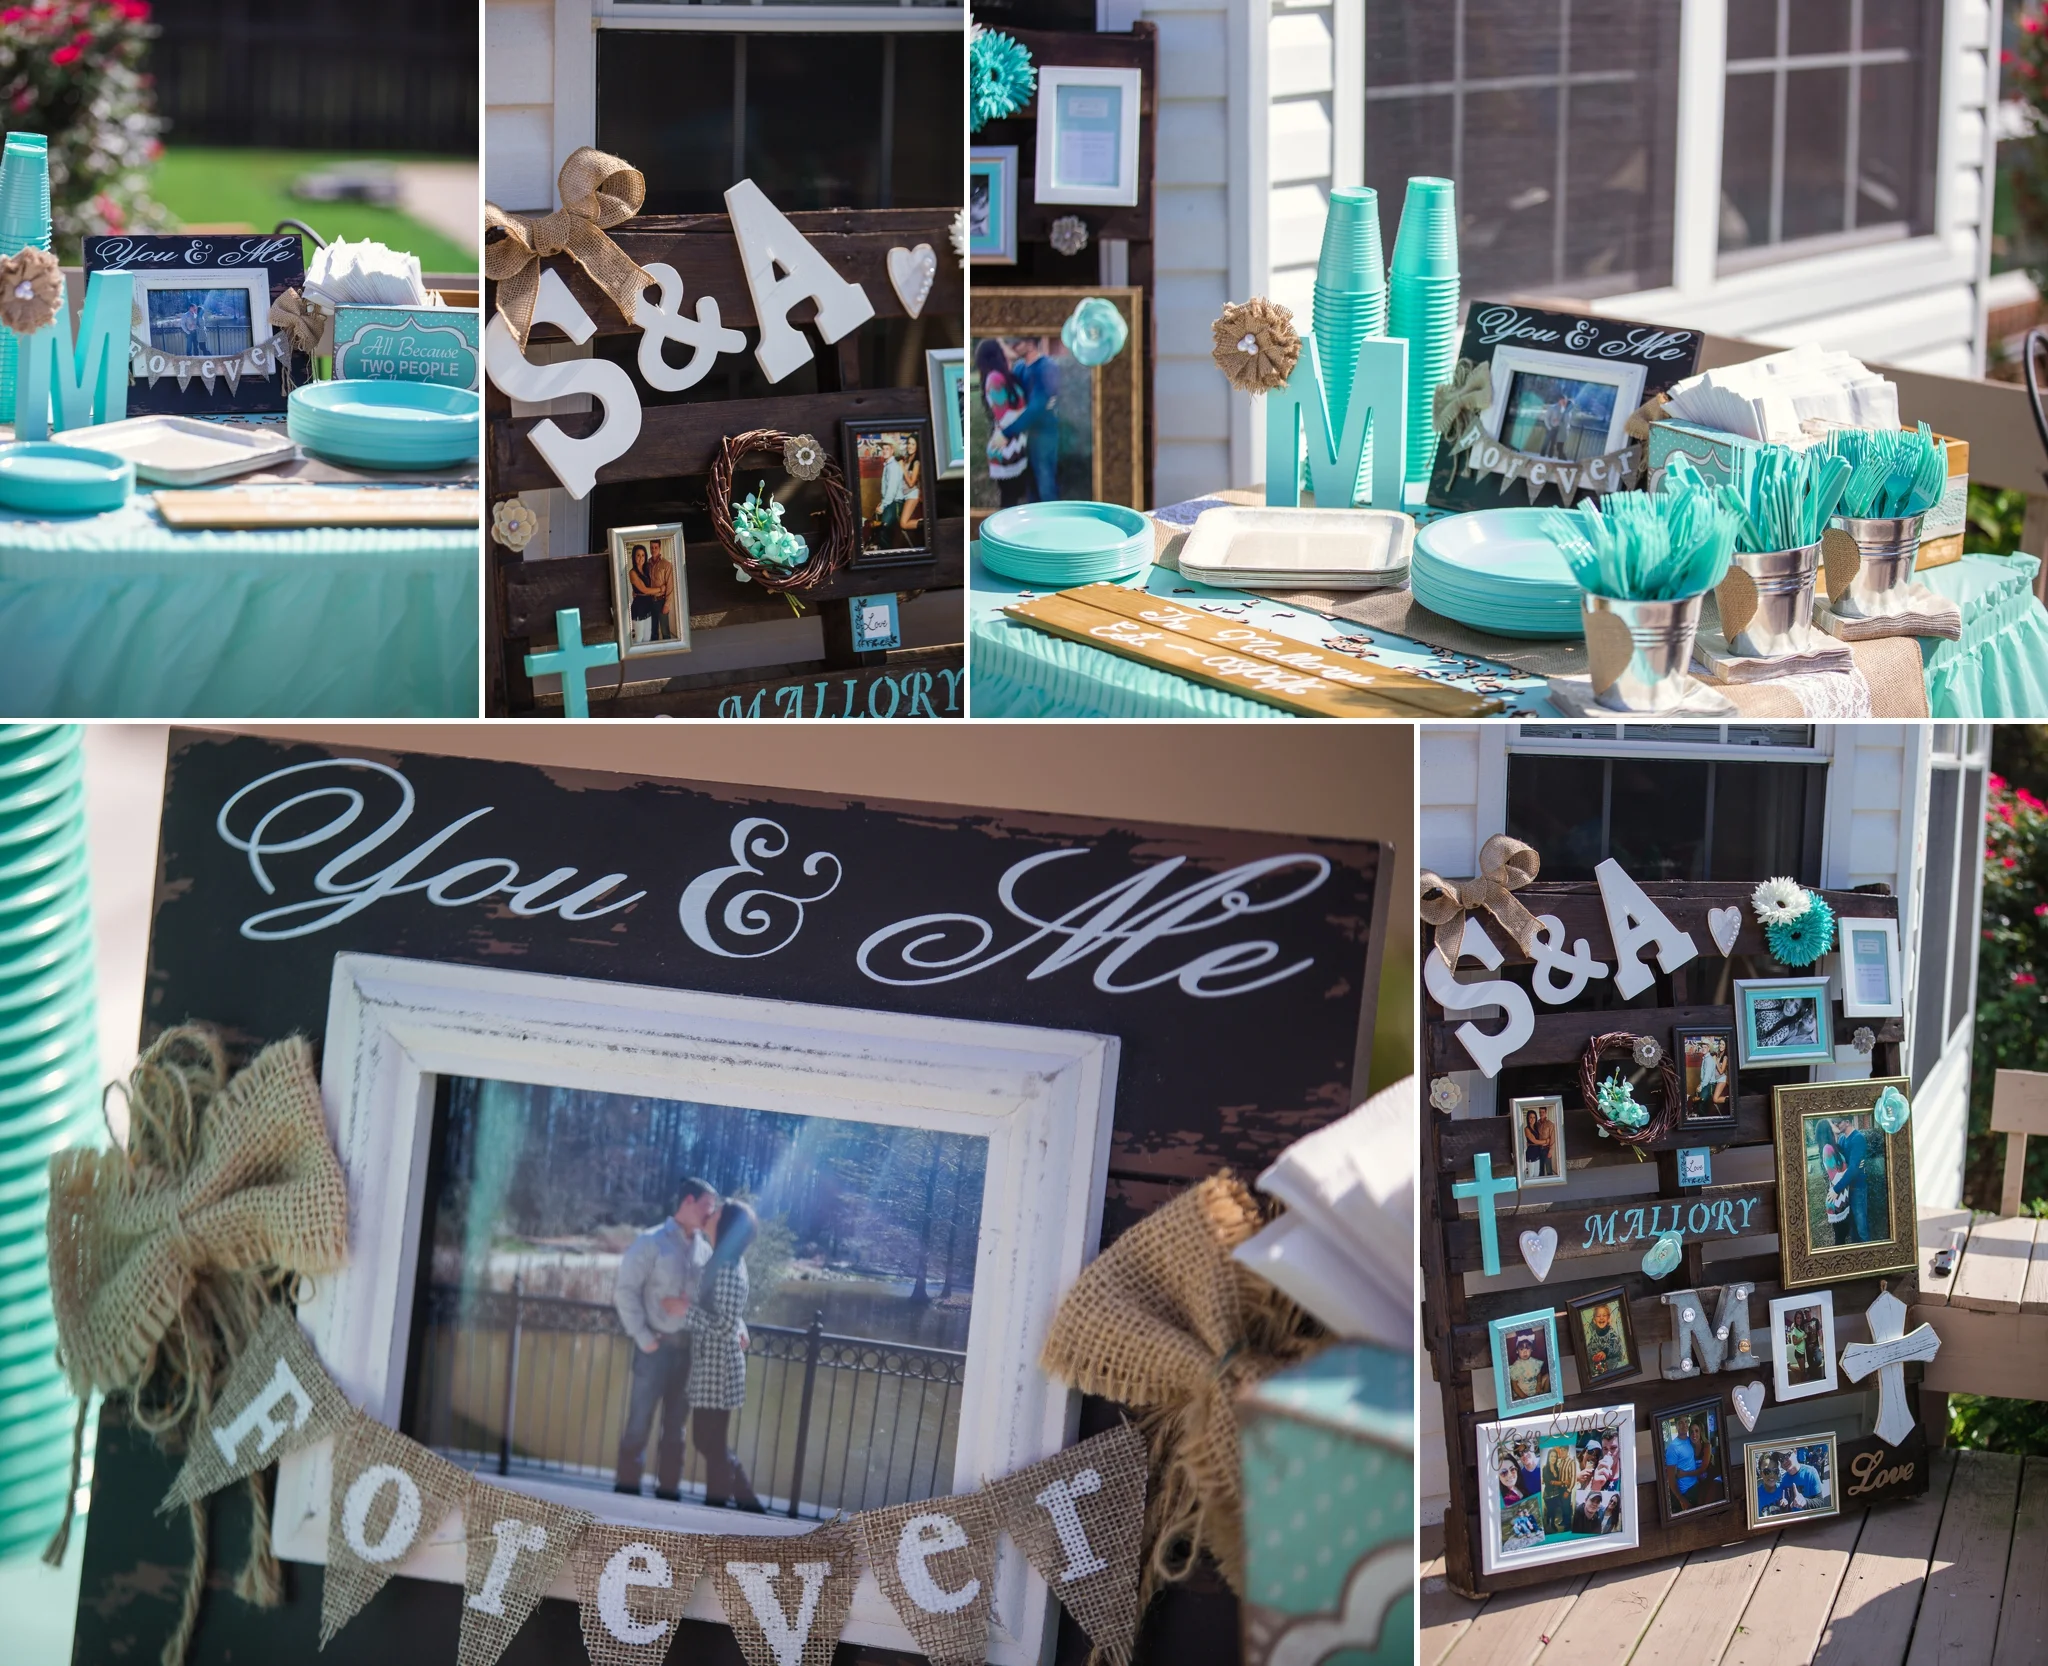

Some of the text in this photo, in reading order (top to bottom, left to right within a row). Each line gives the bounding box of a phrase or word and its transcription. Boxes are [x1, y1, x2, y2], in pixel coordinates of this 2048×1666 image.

[96, 236, 296, 271] You & Me
[361, 335, 459, 359] All Because
[1476, 305, 1692, 361] You & Me
[360, 358, 460, 377] TWO PEOPLE
[1459, 425, 1634, 495] Forever
[863, 612, 889, 631] Love
[1138, 606, 1205, 631] The
[717, 667, 965, 719] MALLORY
[216, 757, 1332, 999] You & Me
[1686, 1159, 1704, 1173] Love
[1582, 1197, 1758, 1249] MALLORY
[1661, 1282, 1760, 1381] M
[1847, 1449, 1915, 1496] Love
[211, 1357, 1108, 1666] Forever
